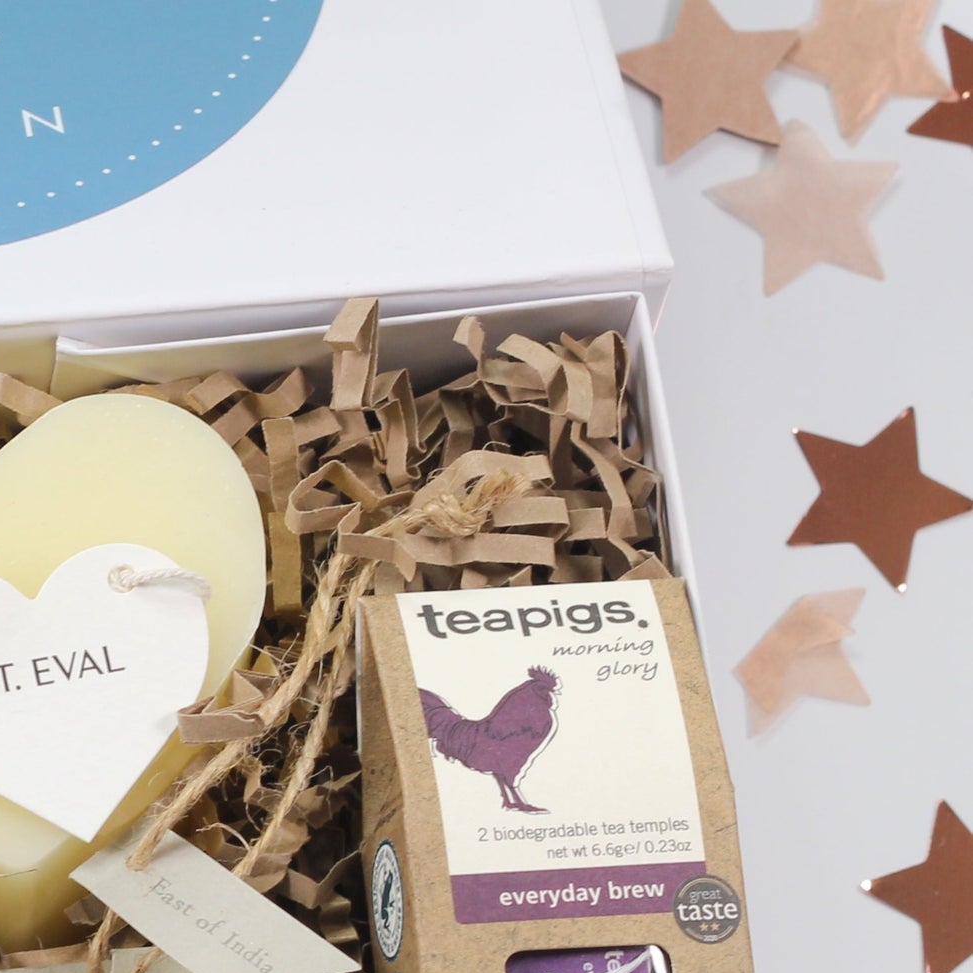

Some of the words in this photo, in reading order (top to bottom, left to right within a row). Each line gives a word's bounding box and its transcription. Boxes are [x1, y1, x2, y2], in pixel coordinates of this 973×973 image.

[417, 599, 650, 639] teapigs.
[552, 637, 655, 658] morning
[32, 645, 126, 687] EVAL
[596, 660, 659, 682] glory
[478, 828, 488, 842] 2
[493, 822, 598, 842] biodegradable
[602, 822, 625, 836] tea
[629, 817, 690, 836] temples
[547, 845, 569, 859] net
[571, 845, 588, 858] wt
[644, 840, 692, 854] 0.23oz
[499, 883, 602, 908] everyday
[608, 881, 665, 900] brew
[689, 889, 722, 904] great
[149, 875, 193, 917] East
[195, 913, 221, 938] of
[676, 901, 739, 921] taste
